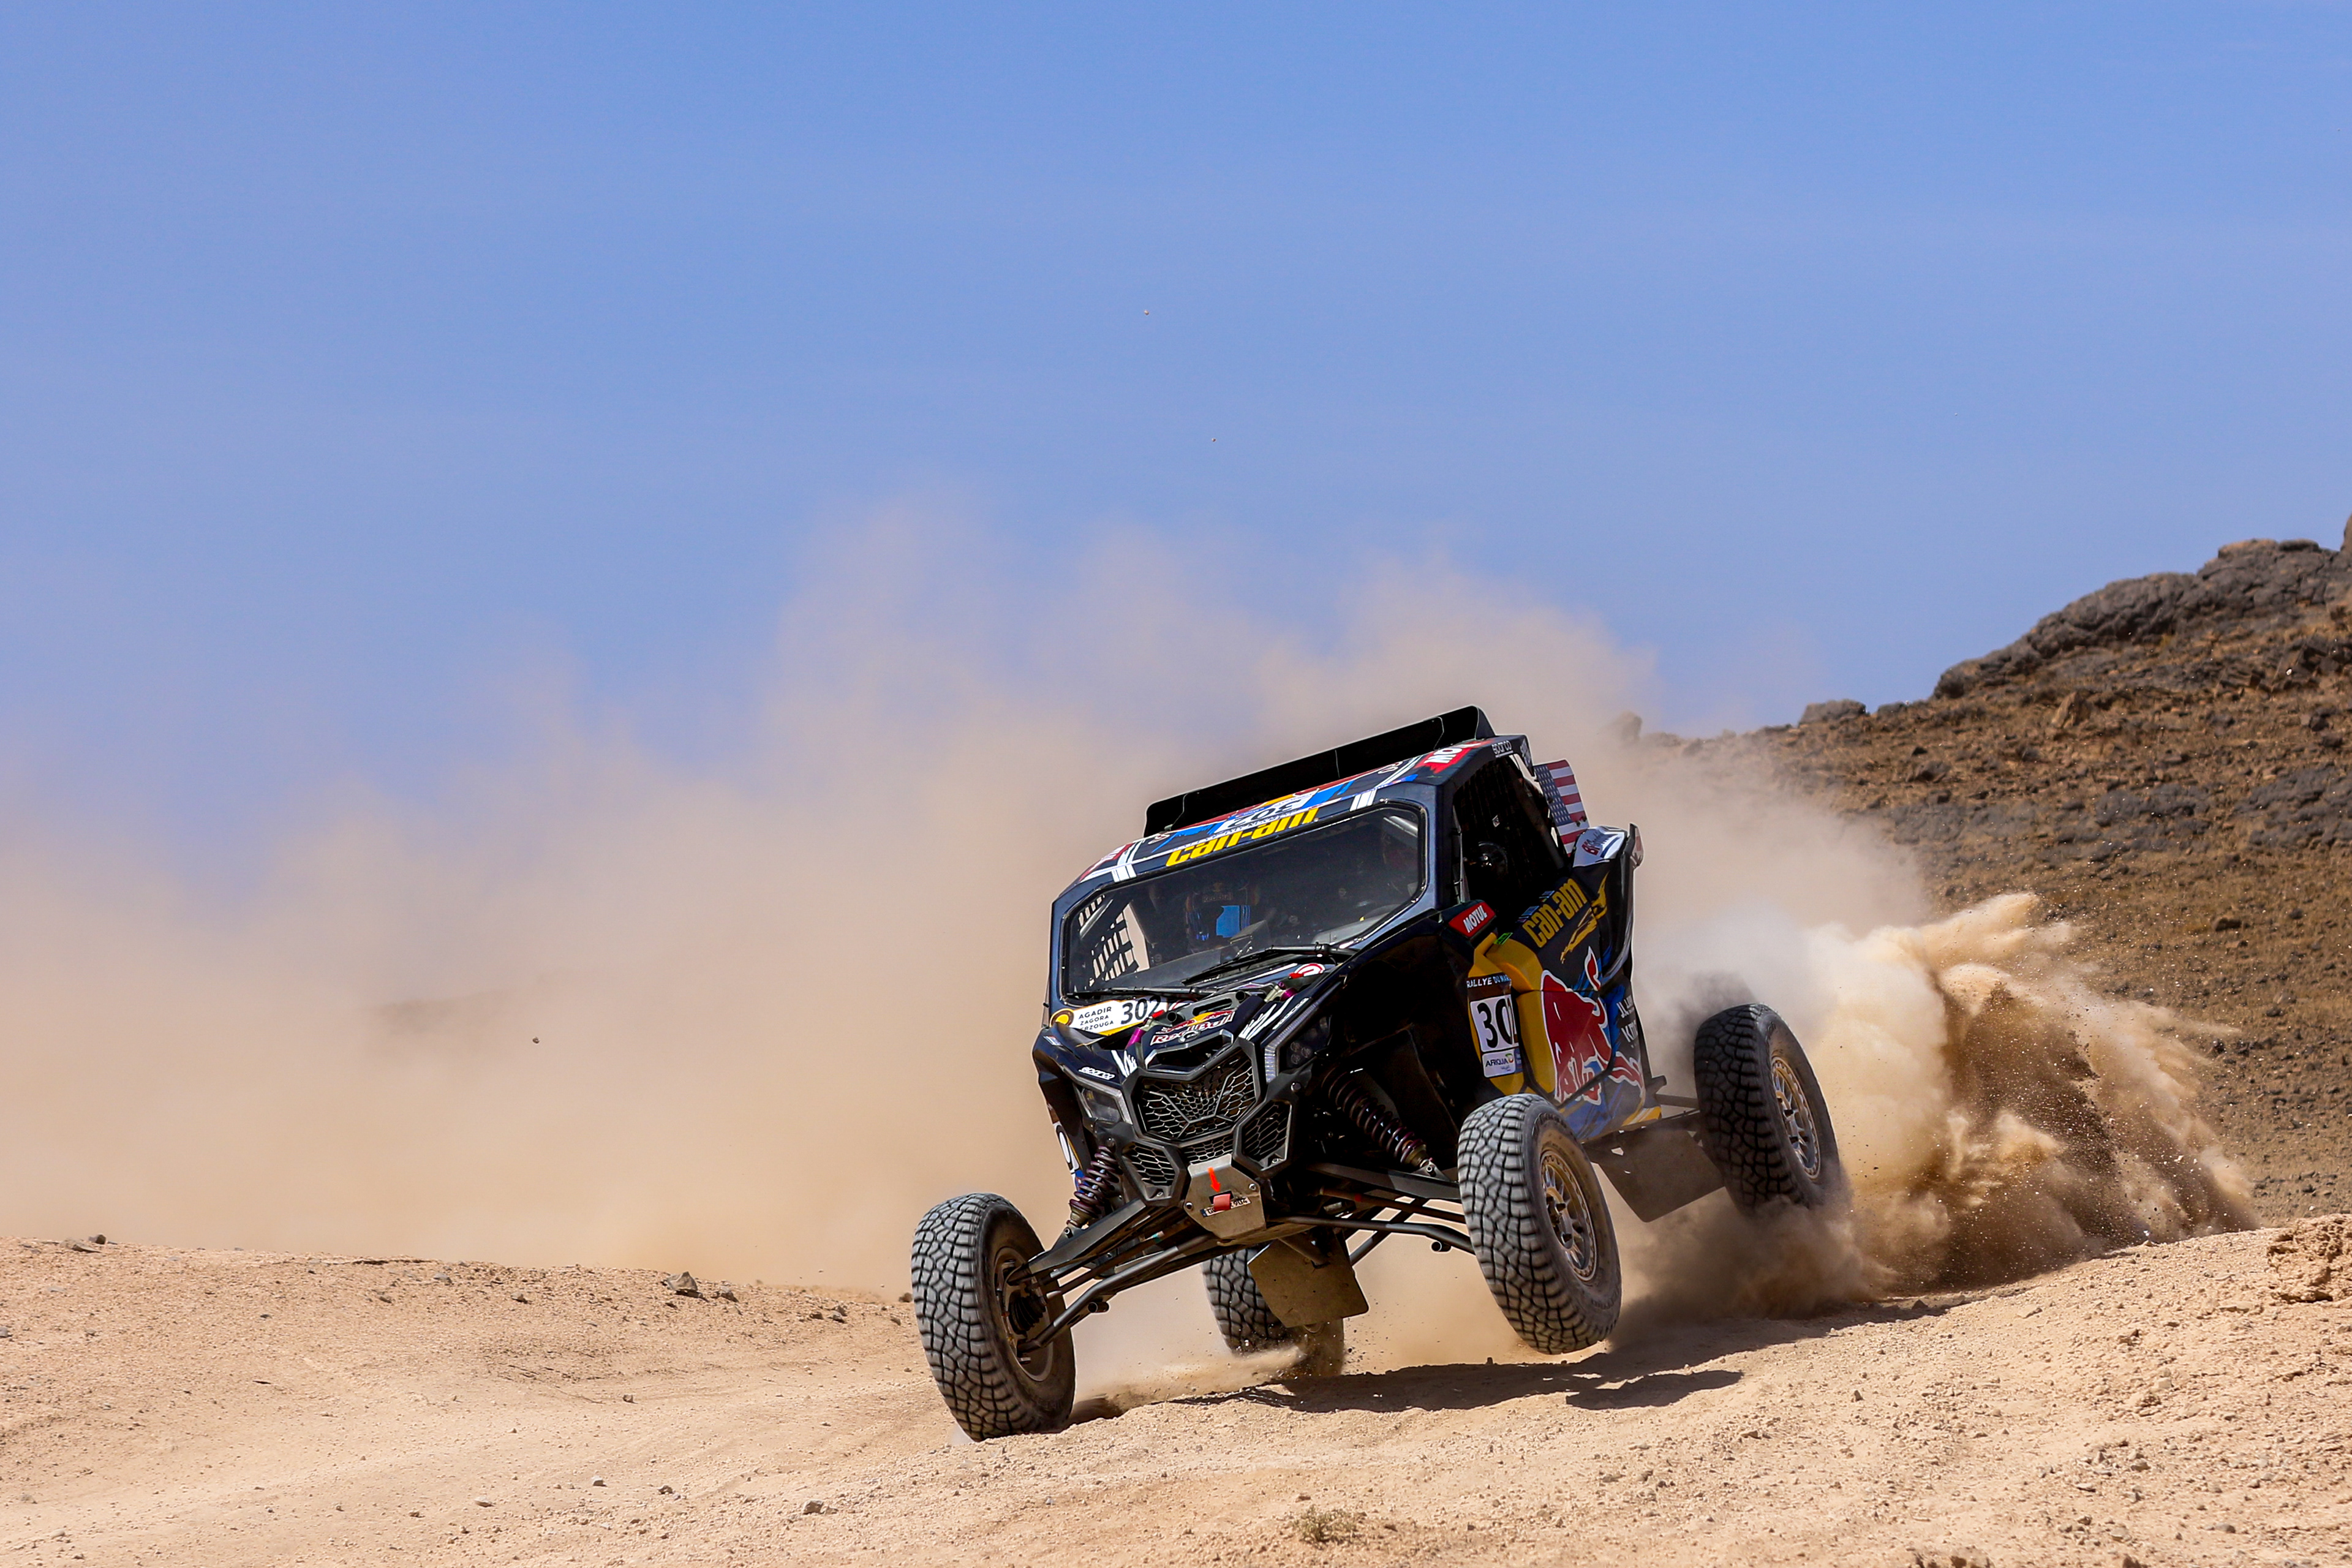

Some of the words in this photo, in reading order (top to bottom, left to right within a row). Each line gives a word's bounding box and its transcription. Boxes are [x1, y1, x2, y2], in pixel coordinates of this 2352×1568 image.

[1166, 807, 1319, 867] can-am
[1462, 905, 1488, 933] MOTUL
[1522, 878, 1588, 948] can-am
[1466, 977, 1493, 989] RALLYE
[1079, 1006, 1112, 1020] AGADIR
[1080, 1014, 1109, 1026] ZAGORA
